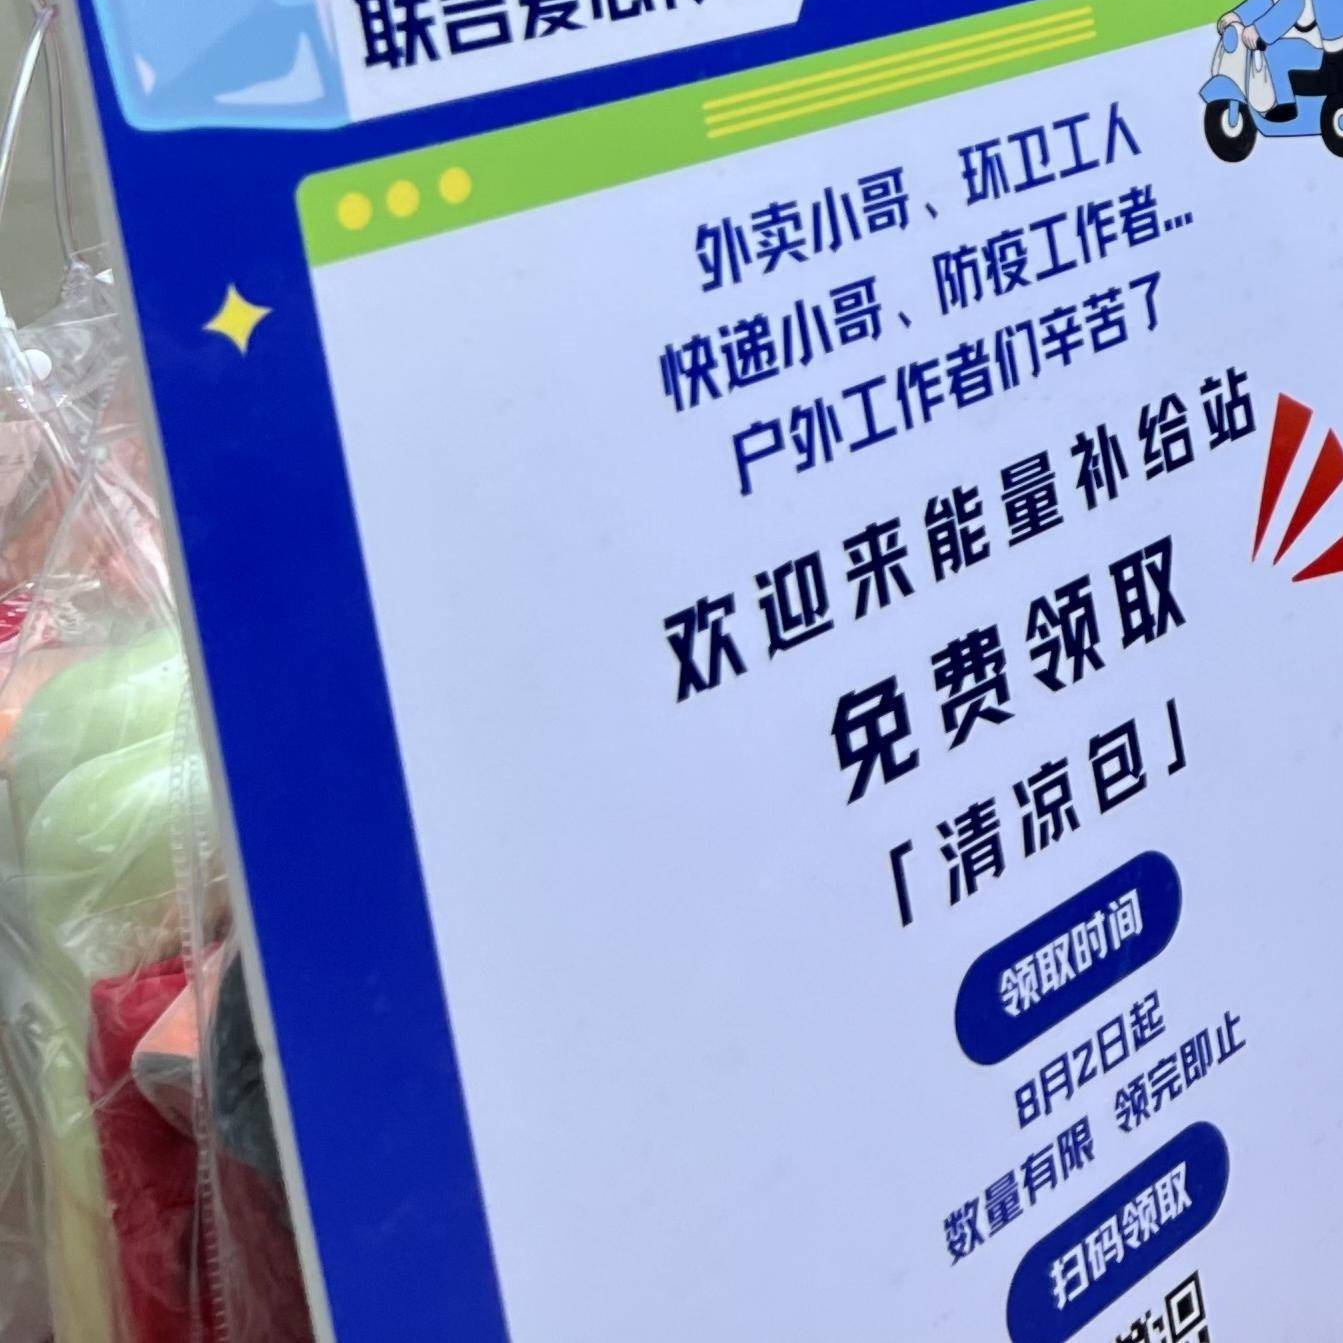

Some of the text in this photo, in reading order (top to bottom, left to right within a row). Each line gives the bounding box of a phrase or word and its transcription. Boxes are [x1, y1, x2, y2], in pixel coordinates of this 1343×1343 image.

[695, 102, 1142, 292] 外卖小哥、环卫工人
[731, 271, 1164, 497] 户外工作者们辛苦了
[663, 365, 1256, 703] 欢迎来能量补给站
[830, 535, 1188, 804] 免费领取
[888, 698, 1189, 927] 「清凉包」
[998, 887, 1143, 1018] 领取时间
[1015, 990, 1167, 1131] 8月2日起
[943, 1011, 1247, 1266] 数量有限 领完即止
[1049, 1161, 1193, 1311] 扫码领取
